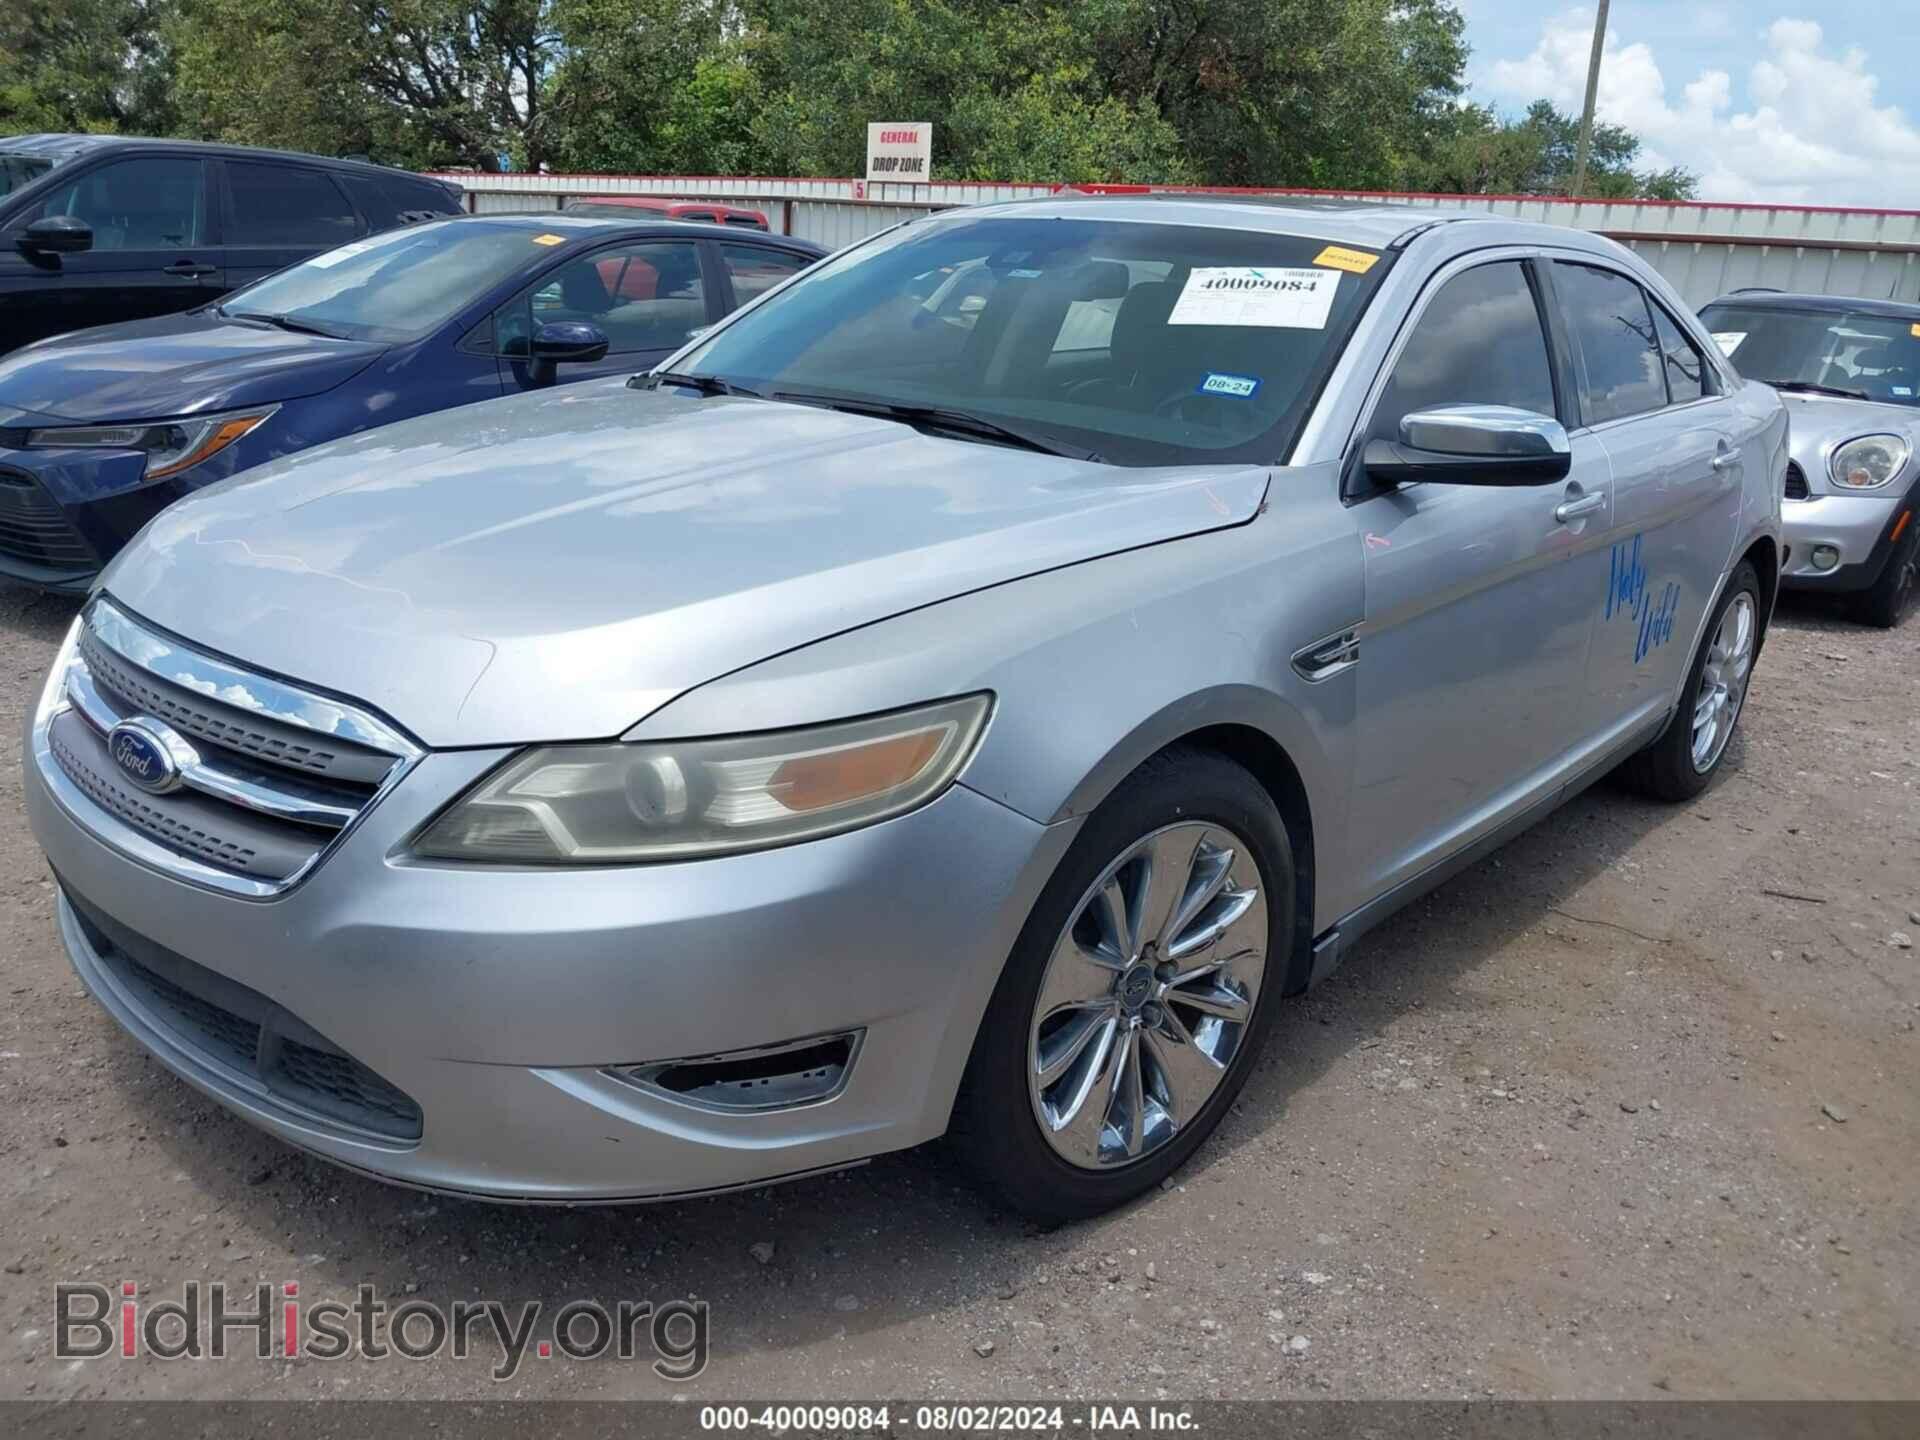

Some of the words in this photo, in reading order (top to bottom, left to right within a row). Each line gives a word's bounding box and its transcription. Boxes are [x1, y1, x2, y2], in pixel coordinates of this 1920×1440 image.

[880, 131, 918, 144] GENERAL
[872, 157, 899, 172] DROP
[899, 157, 924, 172] ZONE
[856, 182, 864, 199] 5
[1200, 278, 1317, 292] 40009084
[116, 735, 153, 776] Ford
